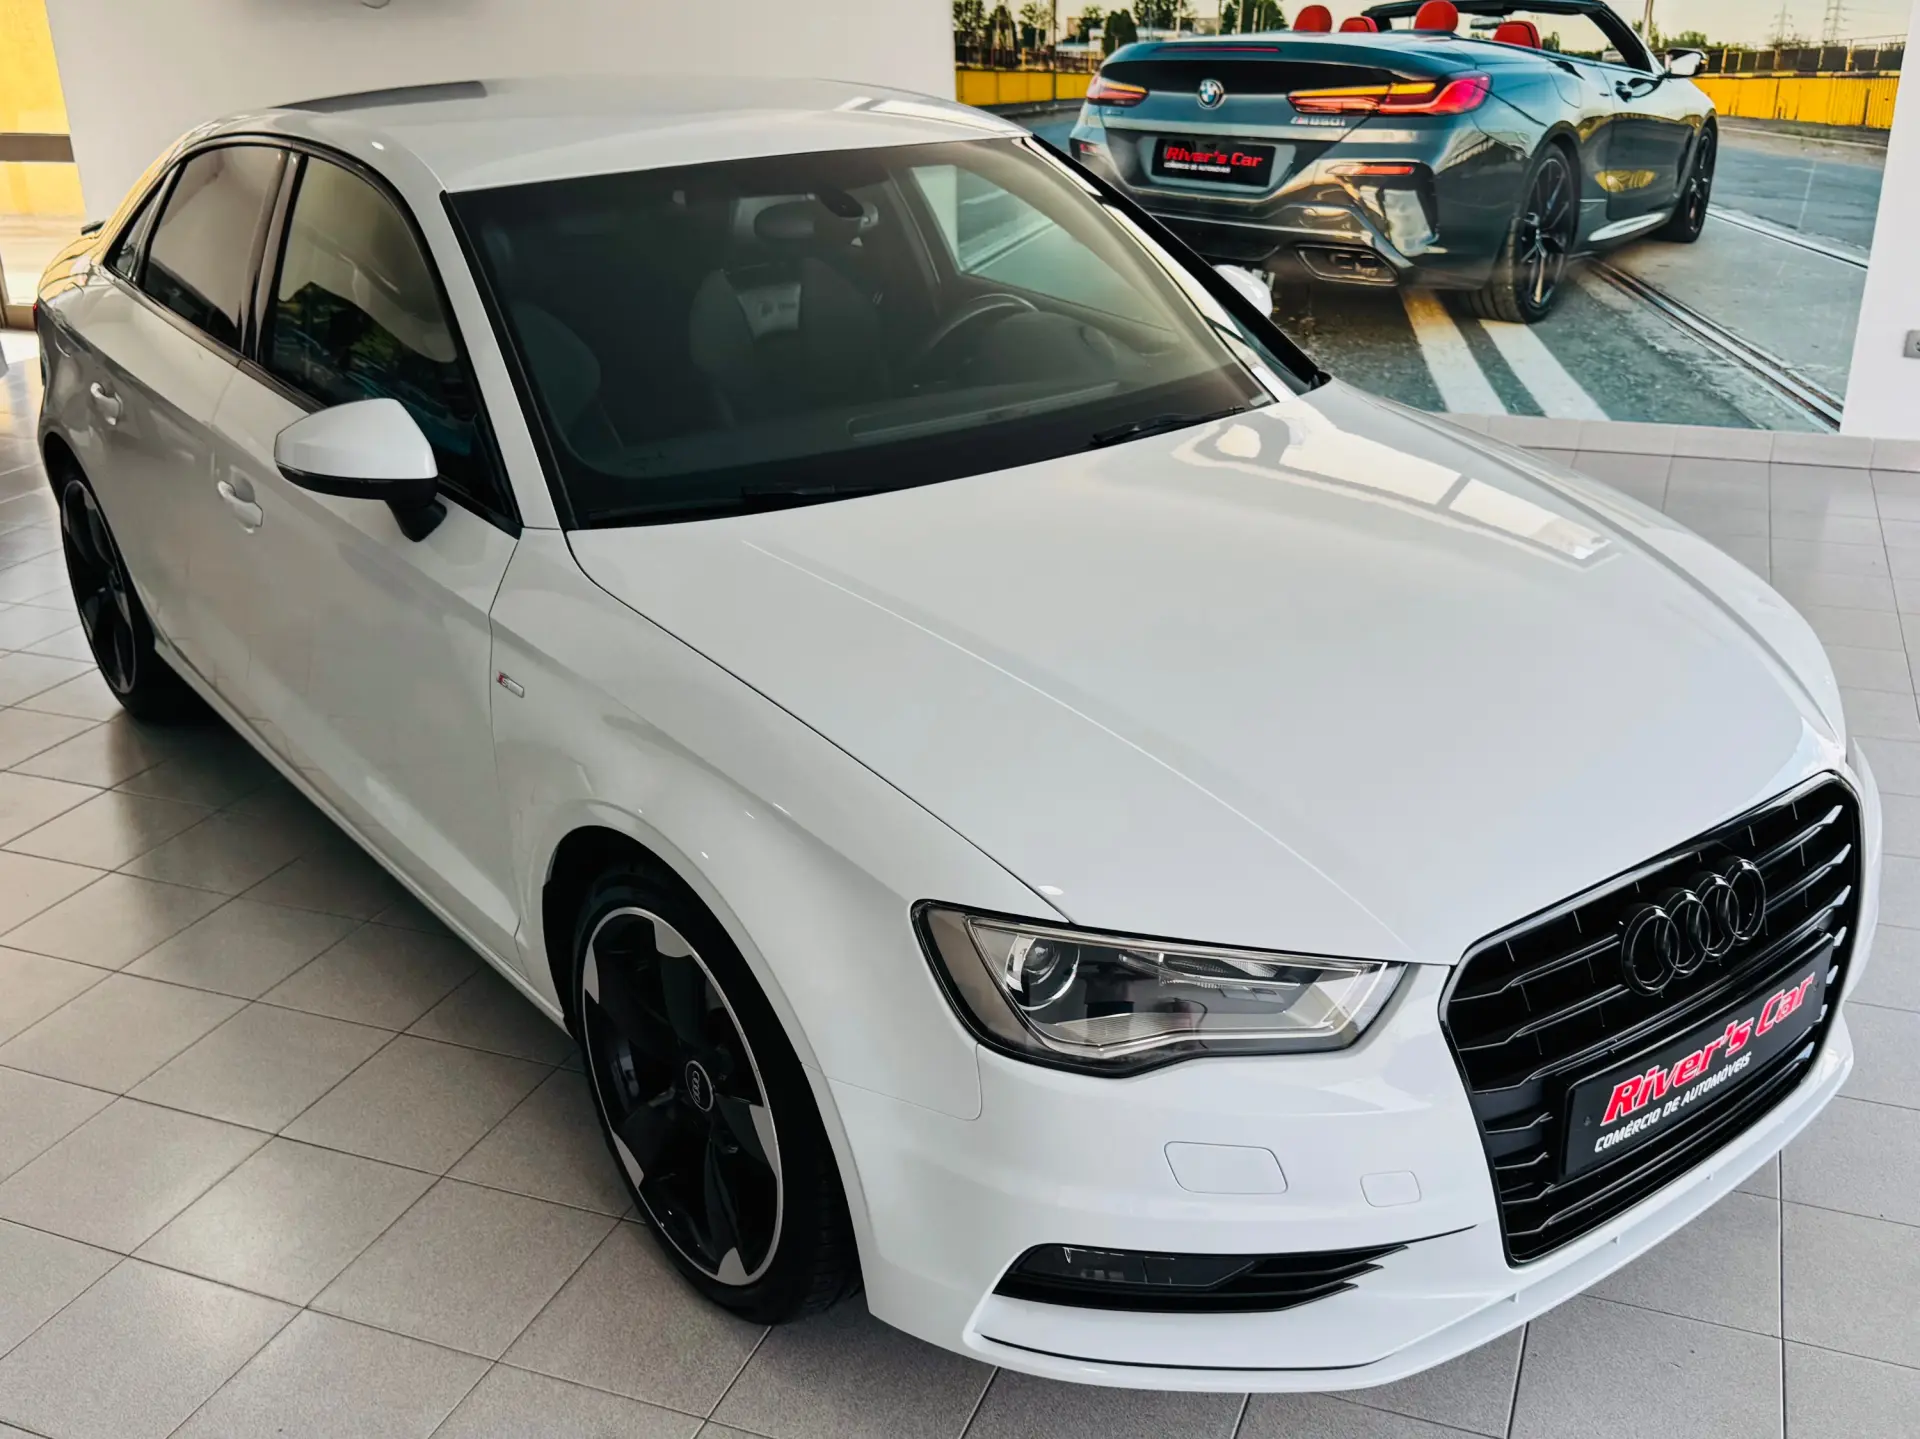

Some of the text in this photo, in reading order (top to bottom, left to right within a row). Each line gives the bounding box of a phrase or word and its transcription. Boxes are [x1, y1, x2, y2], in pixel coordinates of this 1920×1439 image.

[1165, 146, 1229, 165] River's
[1230, 152, 1263, 168] Car
[1600, 971, 1816, 1127] River's Car
[1594, 1051, 1752, 1153] COMÉRCIO DE AUTOMÓVEIS
